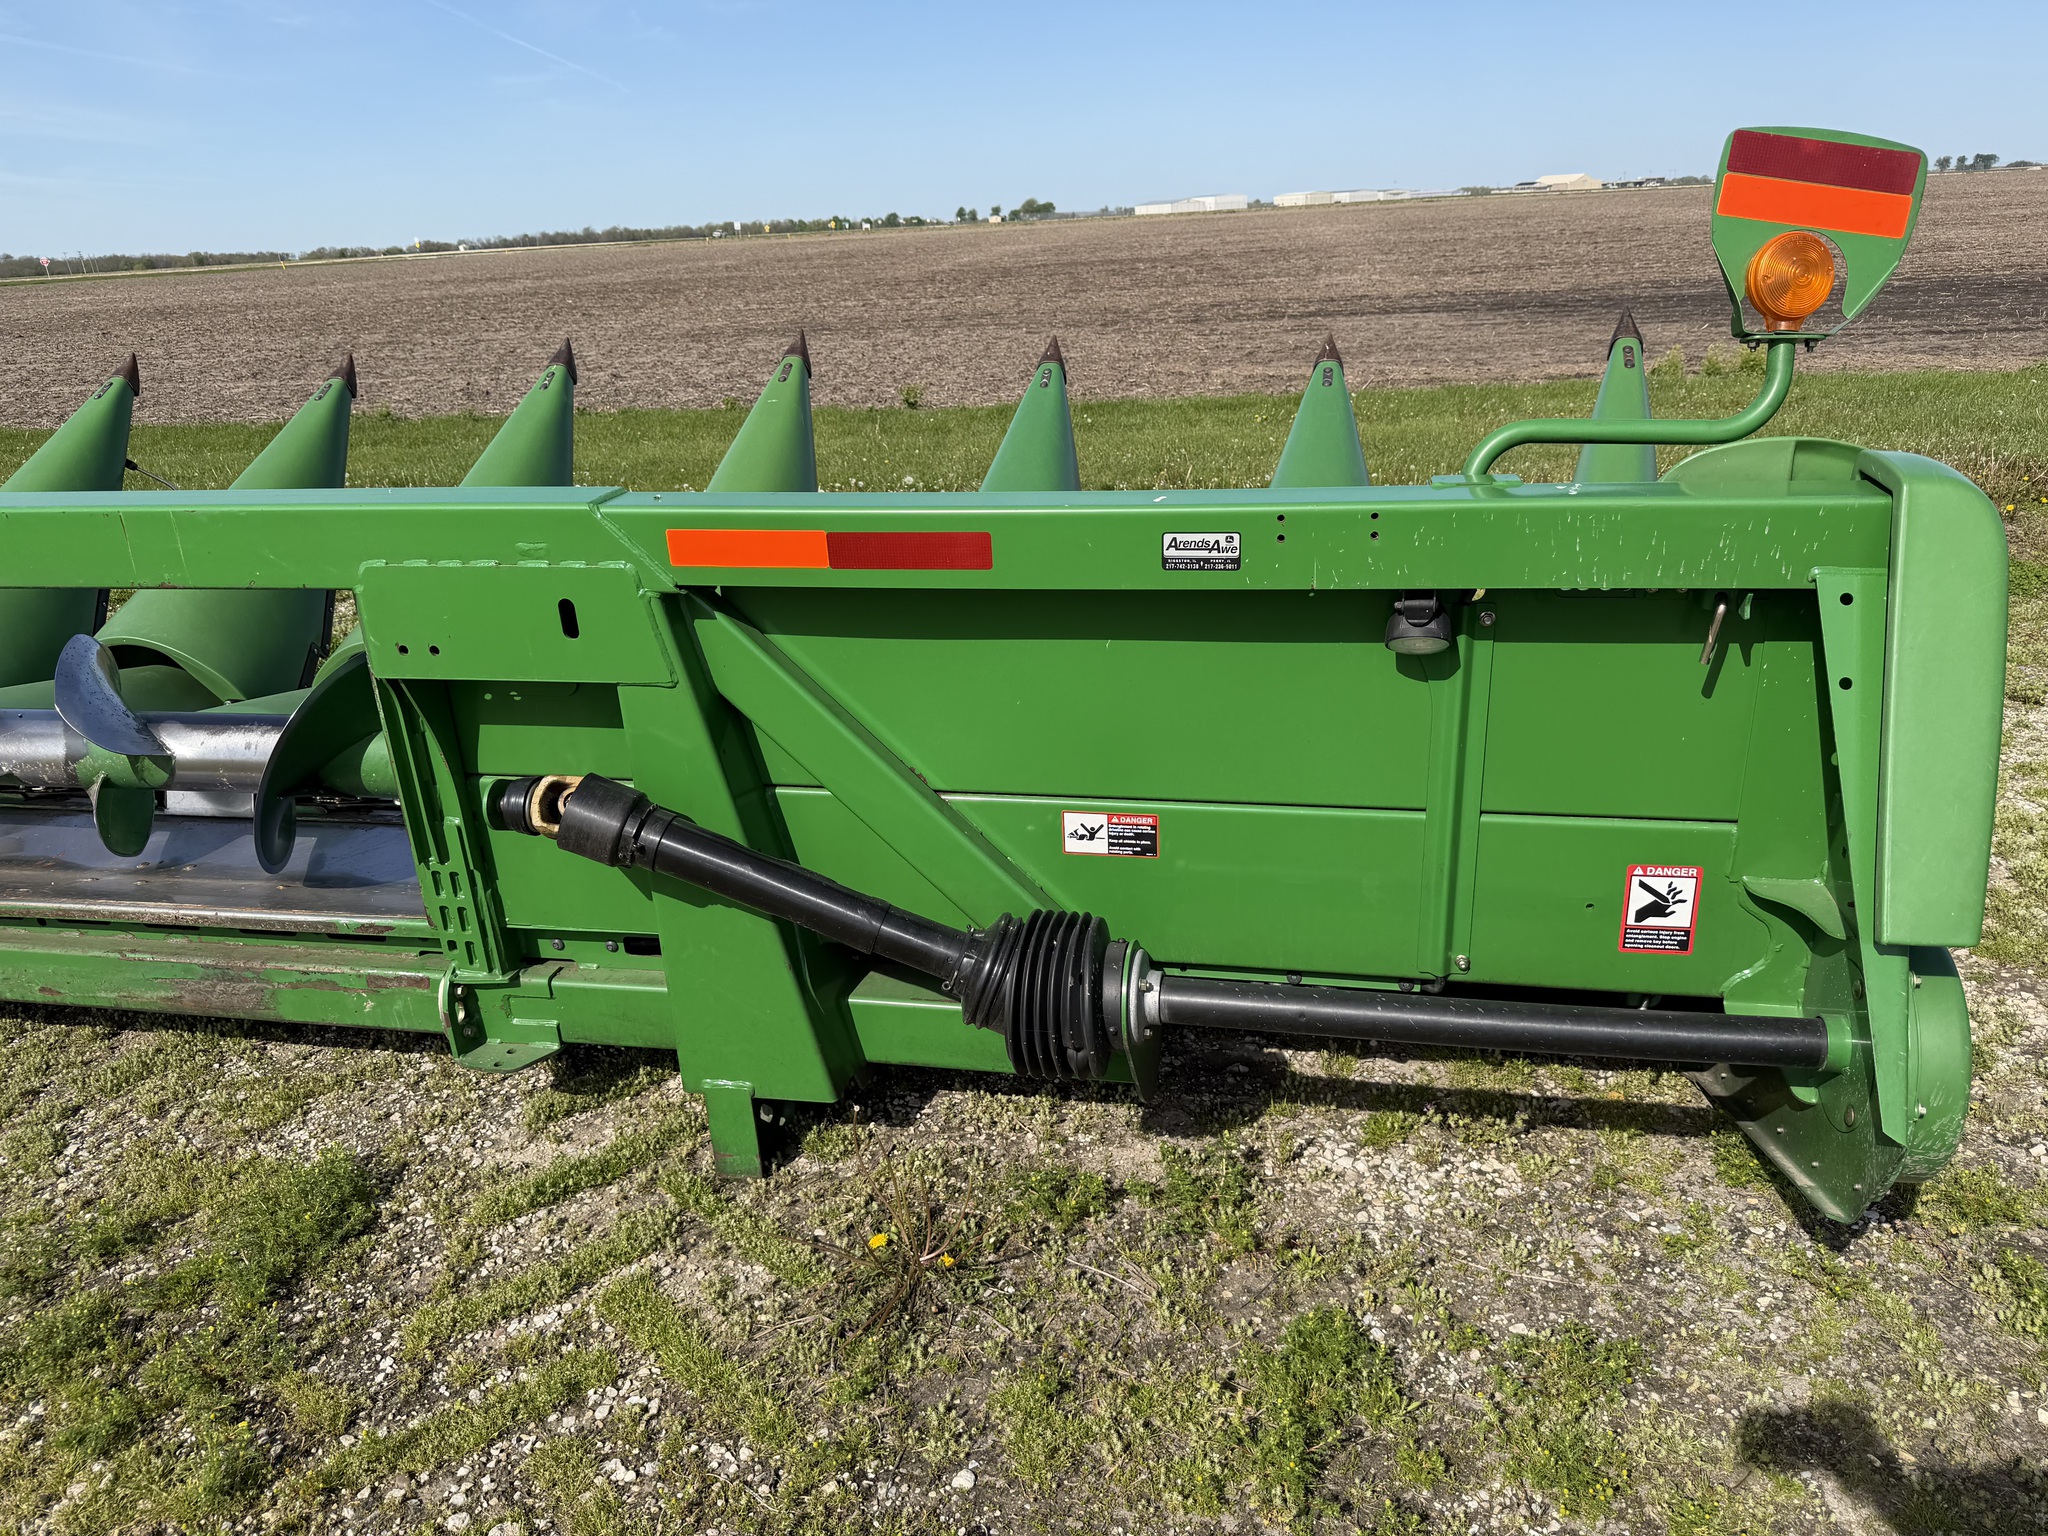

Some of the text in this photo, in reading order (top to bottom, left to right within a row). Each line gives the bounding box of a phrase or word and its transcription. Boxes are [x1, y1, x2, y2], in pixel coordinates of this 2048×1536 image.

[1166, 536, 1238, 554] Arends Awe
[1120, 816, 1153, 824] DANGER
[1646, 867, 1698, 876] DANGER
